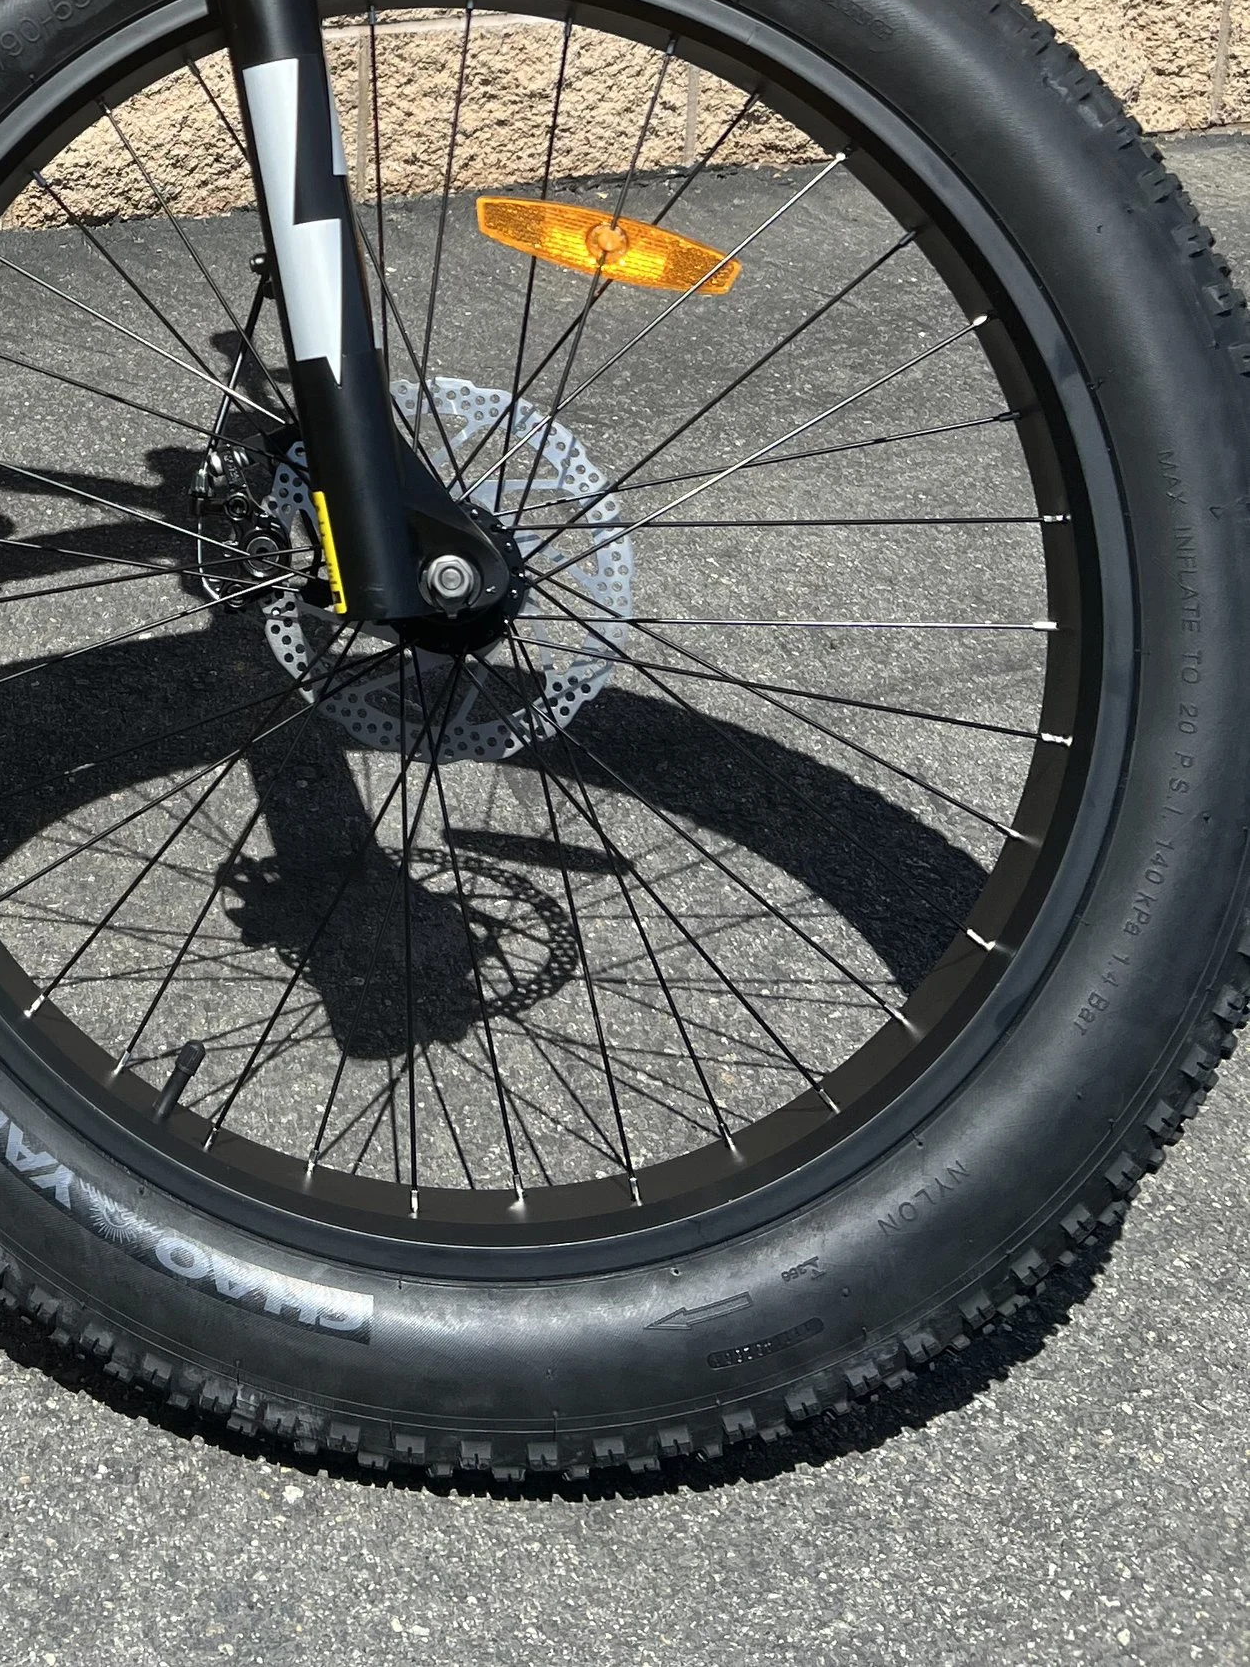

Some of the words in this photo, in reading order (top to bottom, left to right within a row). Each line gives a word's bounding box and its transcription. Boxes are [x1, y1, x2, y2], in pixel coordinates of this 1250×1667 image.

[1157, 449, 1188, 504] MAX
[1172, 526, 1201, 633] INFLATE
[1182, 649, 1203, 685] TO
[1177, 702, 1199, 735] 20
[1144, 840, 1175, 885] 140
[1101, 954, 1131, 987] 1.4
[1073, 991, 1111, 1036] Bar
[877, 1160, 971, 1237] NYLON
[153, 1233, 374, 1334] CHAO
